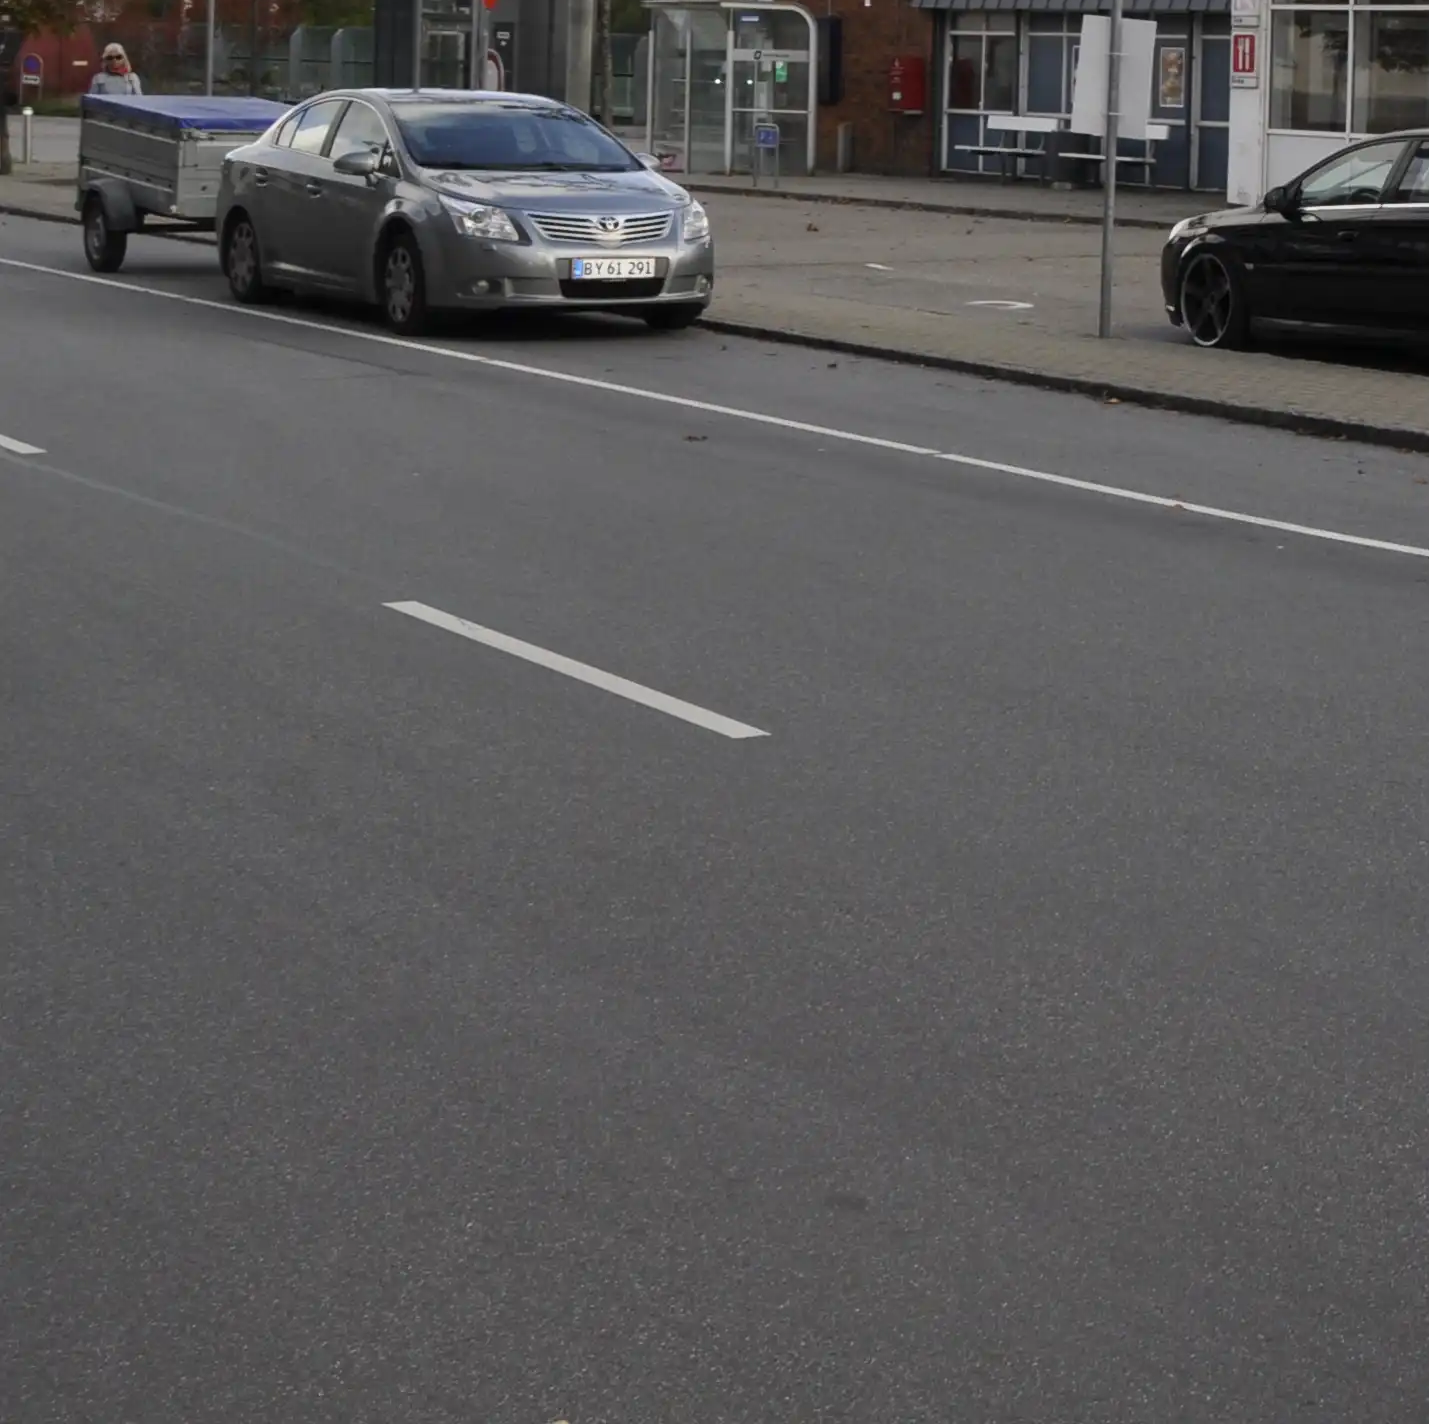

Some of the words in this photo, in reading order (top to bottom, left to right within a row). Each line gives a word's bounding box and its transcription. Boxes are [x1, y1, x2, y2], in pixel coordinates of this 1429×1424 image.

[584, 261, 603, 275] BY
[607, 262, 622, 275] 61
[628, 261, 652, 274] 291
